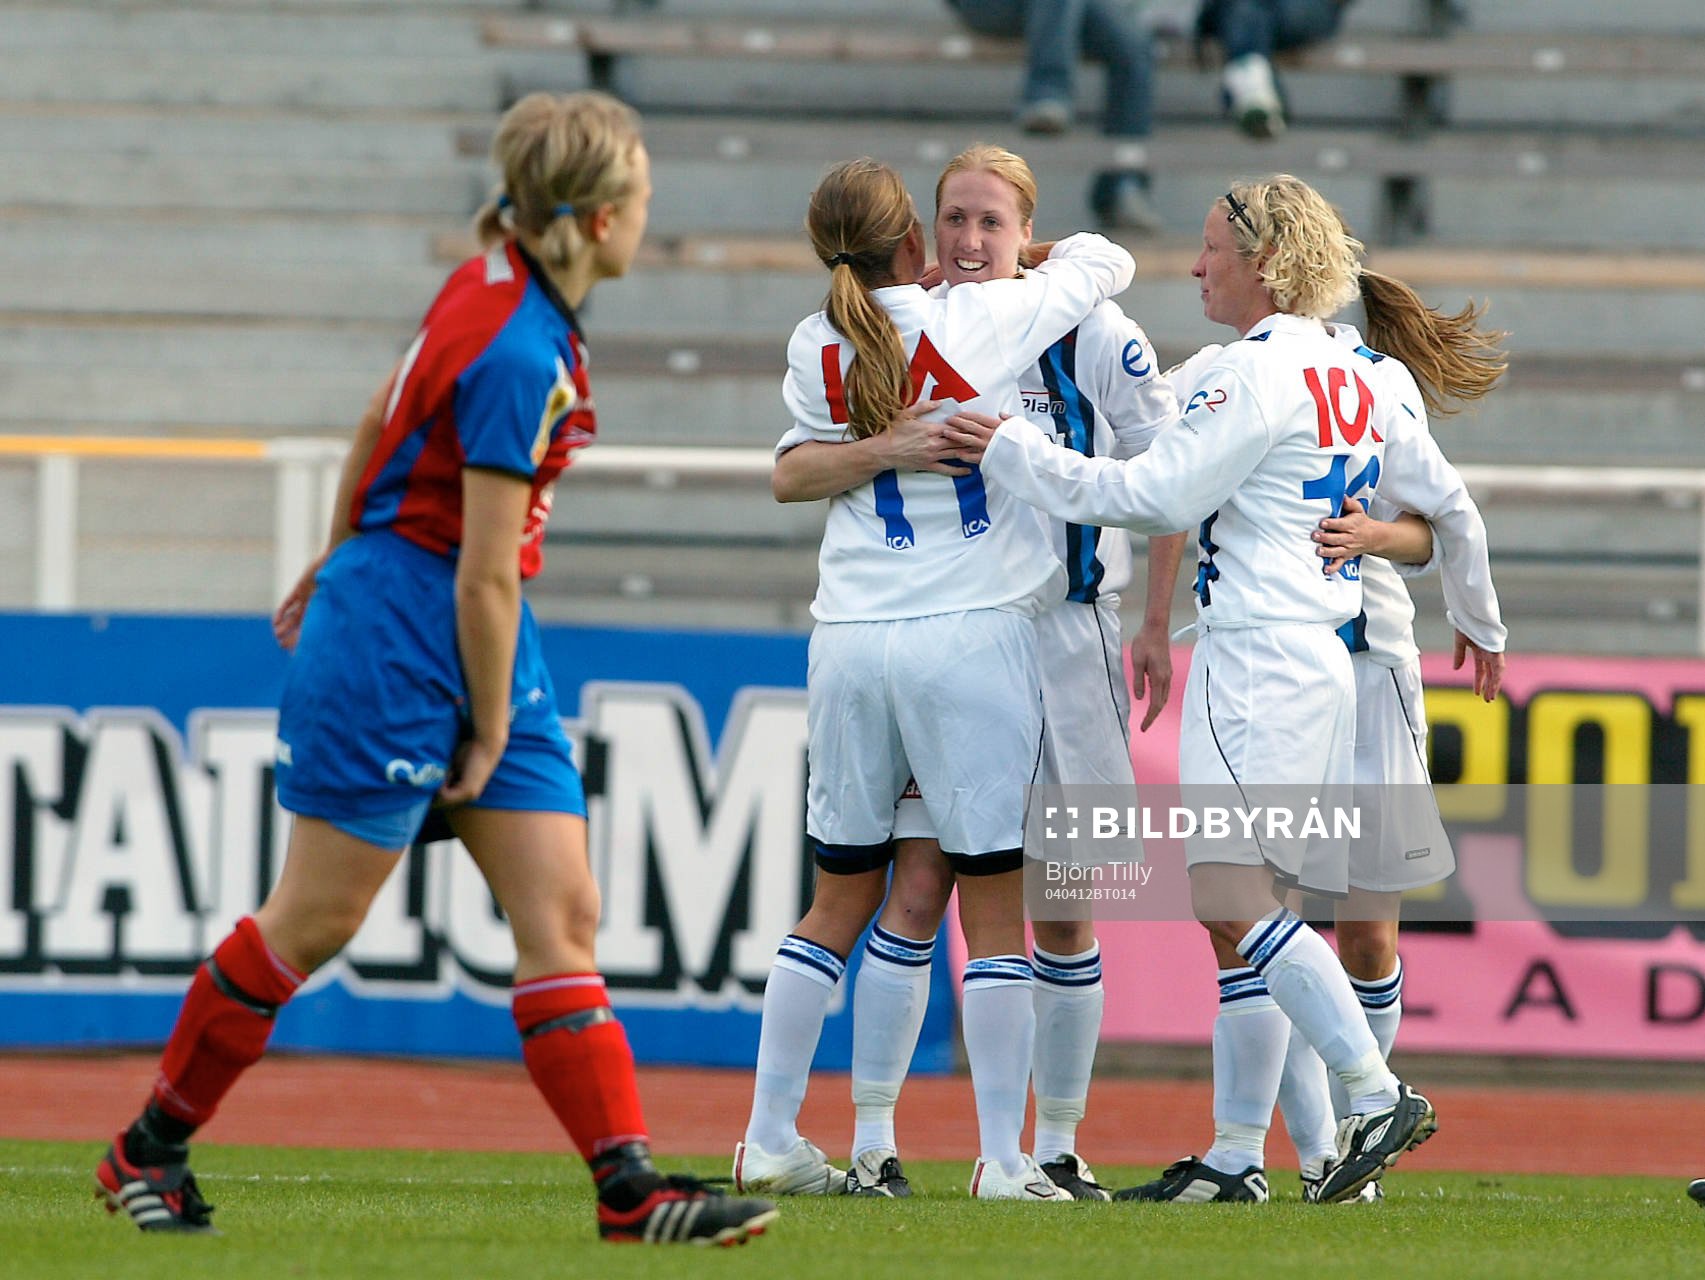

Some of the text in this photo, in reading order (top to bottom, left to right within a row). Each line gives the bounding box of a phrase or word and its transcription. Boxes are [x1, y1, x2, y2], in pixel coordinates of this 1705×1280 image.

[822, 330, 981, 425] IA
[962, 519, 990, 538] ICA
[886, 536, 914, 550] ICA
